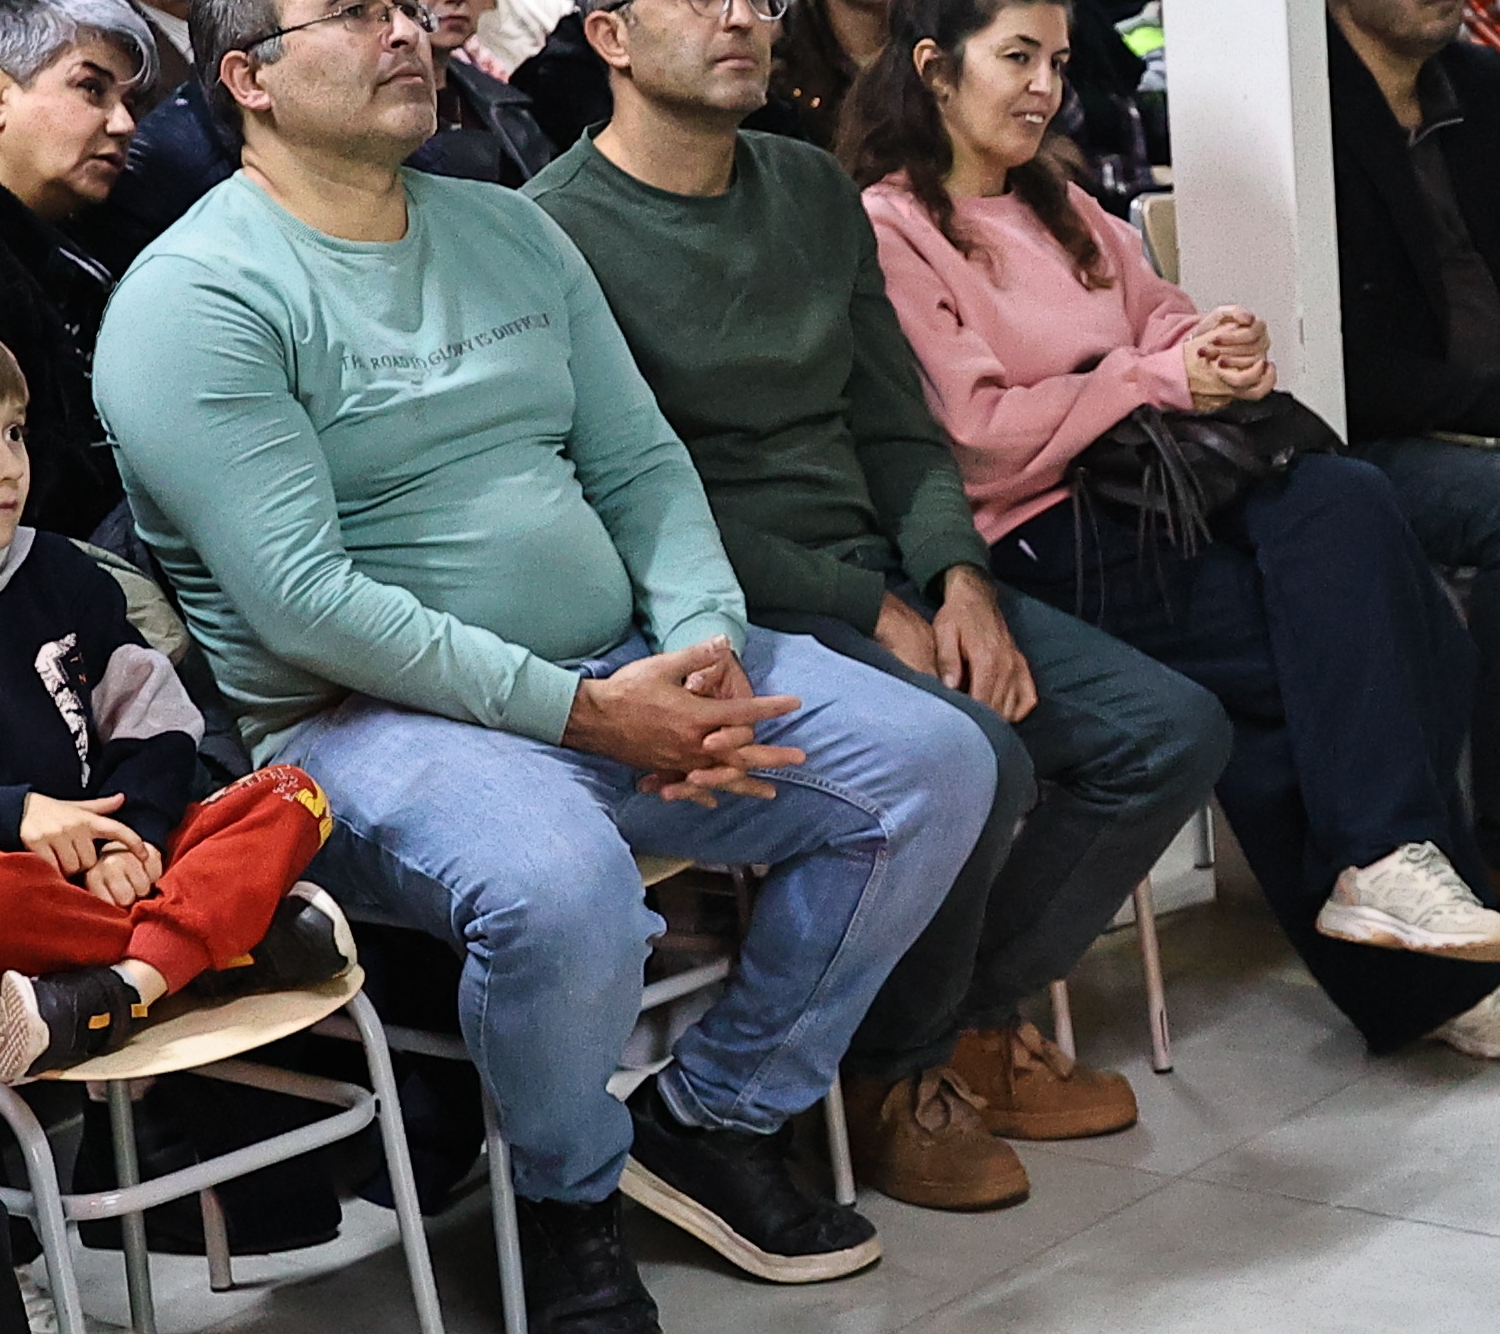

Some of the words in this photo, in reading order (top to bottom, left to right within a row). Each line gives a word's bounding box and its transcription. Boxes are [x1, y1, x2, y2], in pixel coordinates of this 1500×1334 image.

[340, 353, 368, 371] TH
[370, 355, 409, 370] ROAD
[475, 332, 492, 348] IS
[492, 313, 550, 341] DIFFIT
